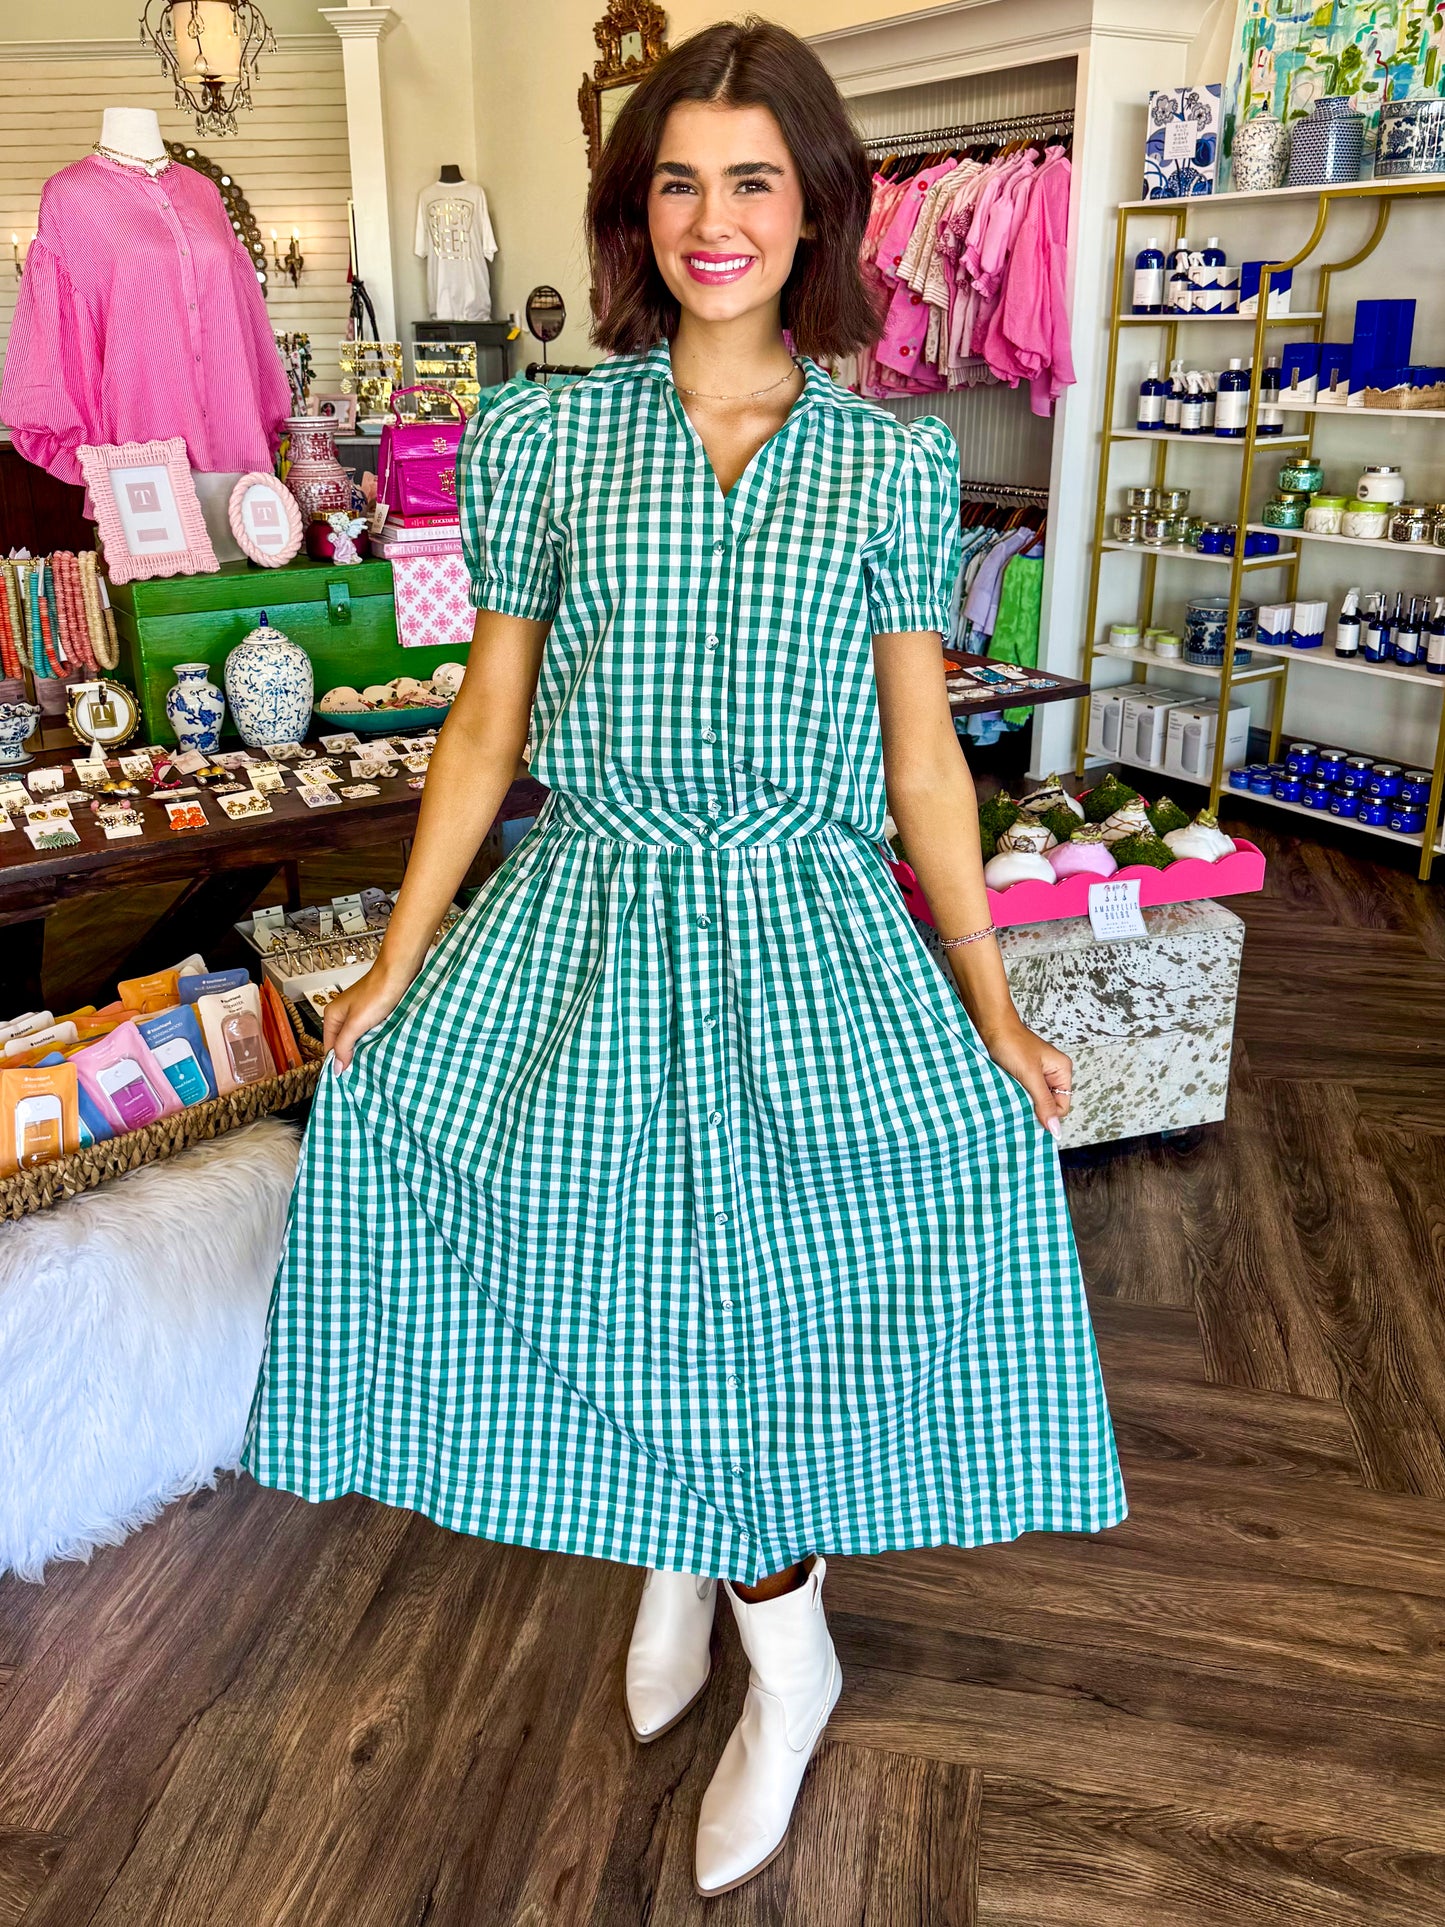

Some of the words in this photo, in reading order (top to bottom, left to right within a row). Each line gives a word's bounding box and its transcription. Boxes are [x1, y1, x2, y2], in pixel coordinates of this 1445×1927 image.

[134, 489, 151, 506] T
[257, 507, 272, 521] T
[394, 544, 442, 555] HARLOTTE
[92, 705, 110, 721] T
